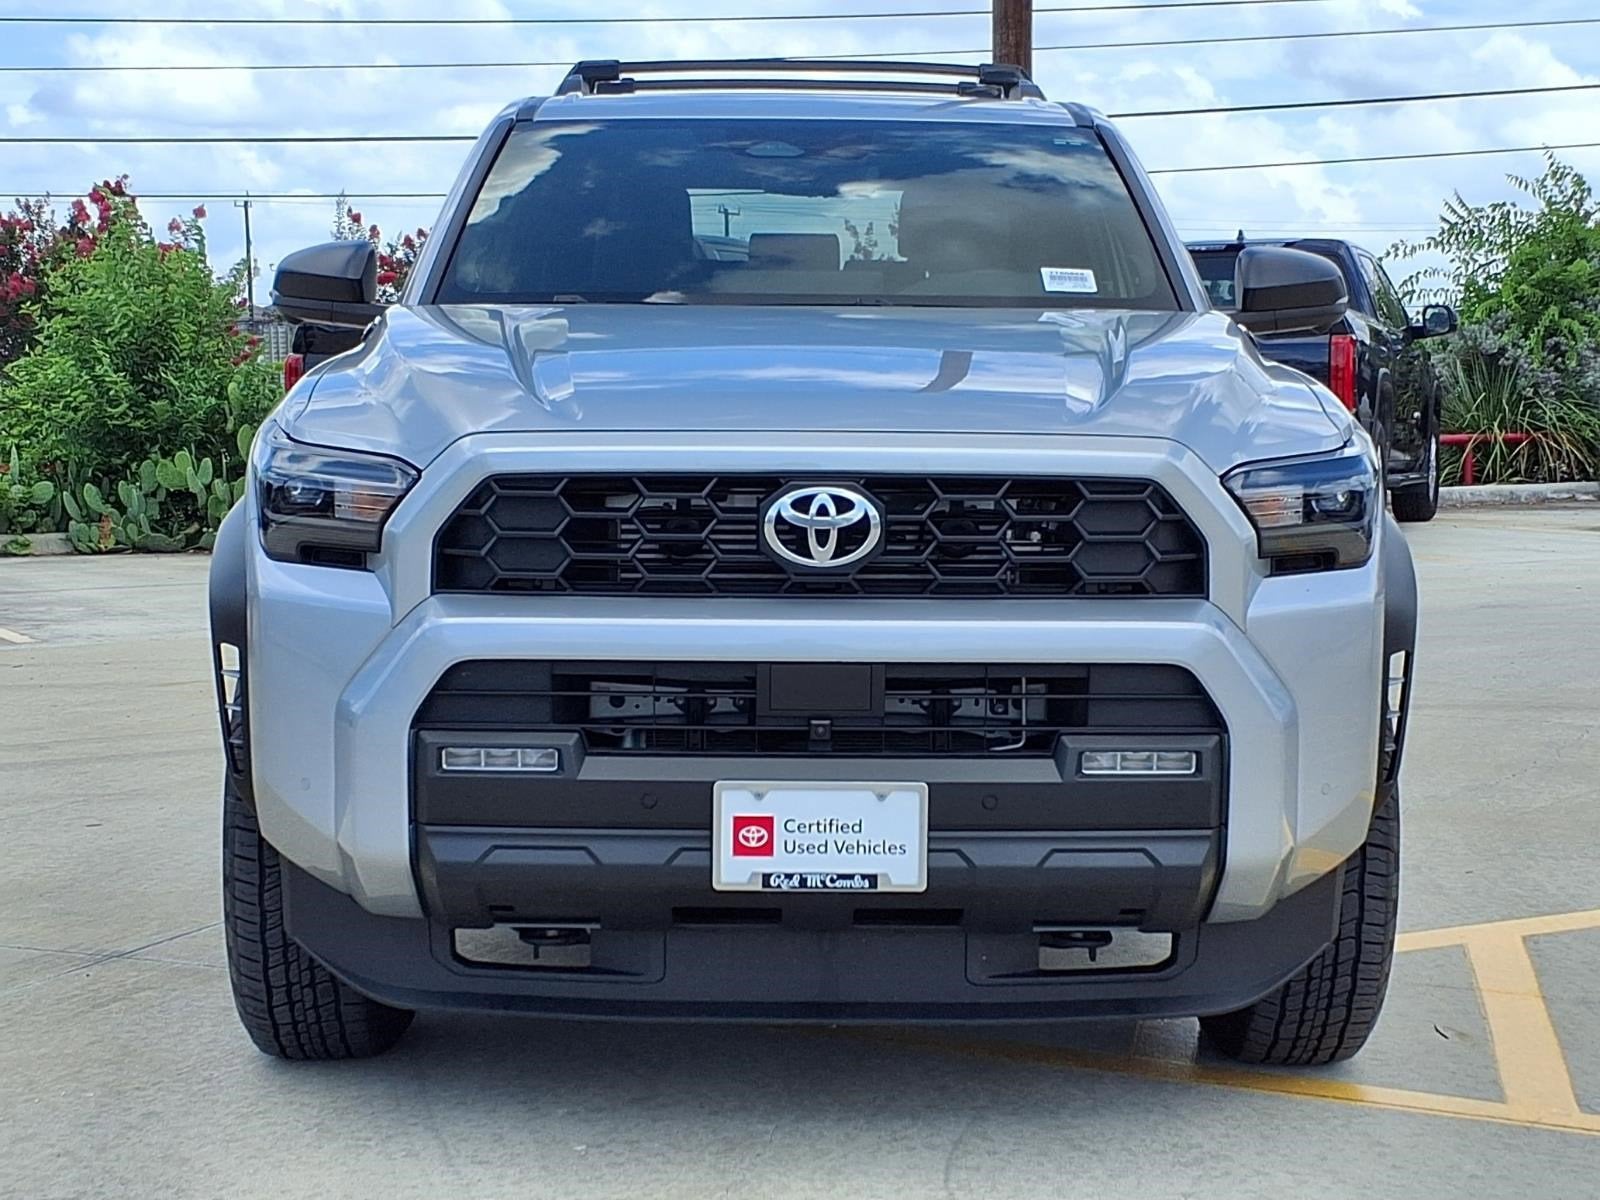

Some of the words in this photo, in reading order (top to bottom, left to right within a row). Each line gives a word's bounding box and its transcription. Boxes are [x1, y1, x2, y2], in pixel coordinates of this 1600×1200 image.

[783, 818, 863, 834] Certified
[783, 839, 829, 855] Used
[834, 839, 907, 855] Vehicles
[769, 873, 800, 890] Red
[801, 873, 870, 889] McCombs
